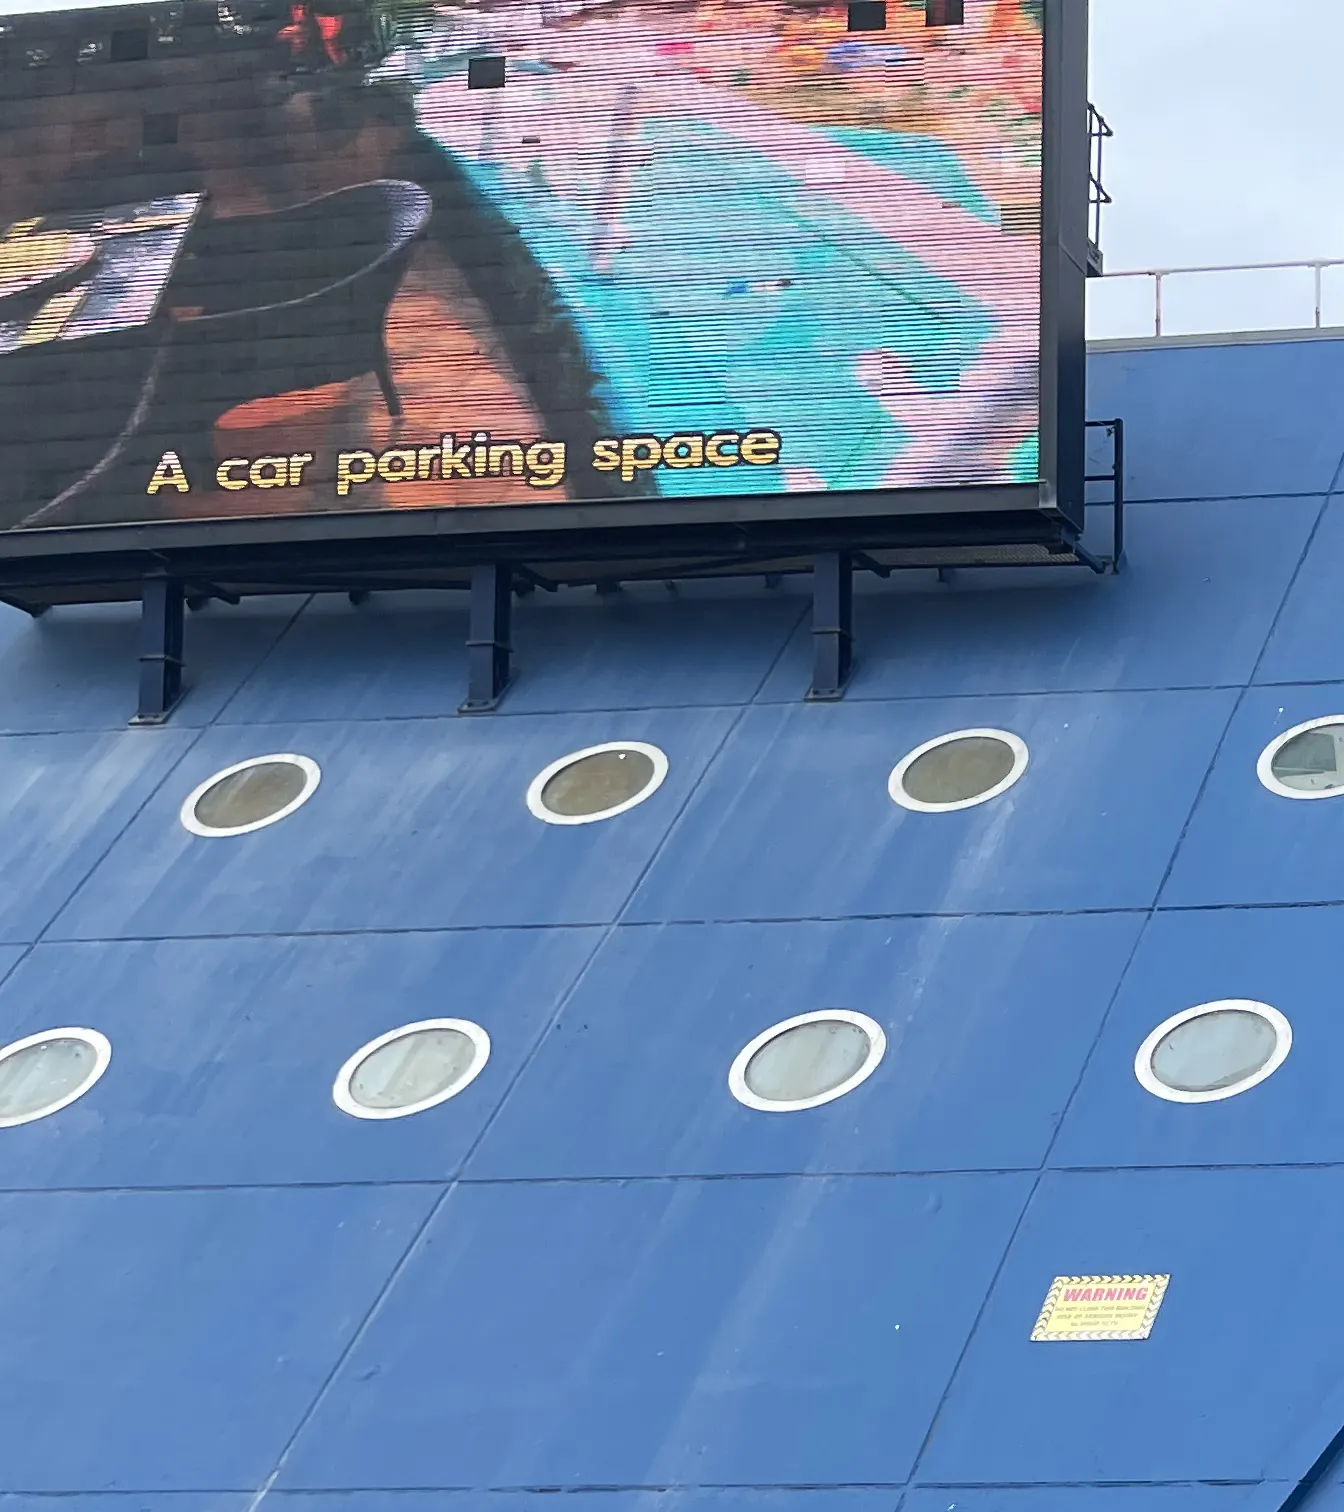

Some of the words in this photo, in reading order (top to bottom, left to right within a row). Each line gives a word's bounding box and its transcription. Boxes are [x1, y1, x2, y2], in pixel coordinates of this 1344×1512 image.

[146, 451, 190, 496] A
[215, 449, 311, 492] car
[335, 430, 568, 496] parking
[590, 425, 782, 483] space
[1063, 1287, 1149, 1302] WARNING
